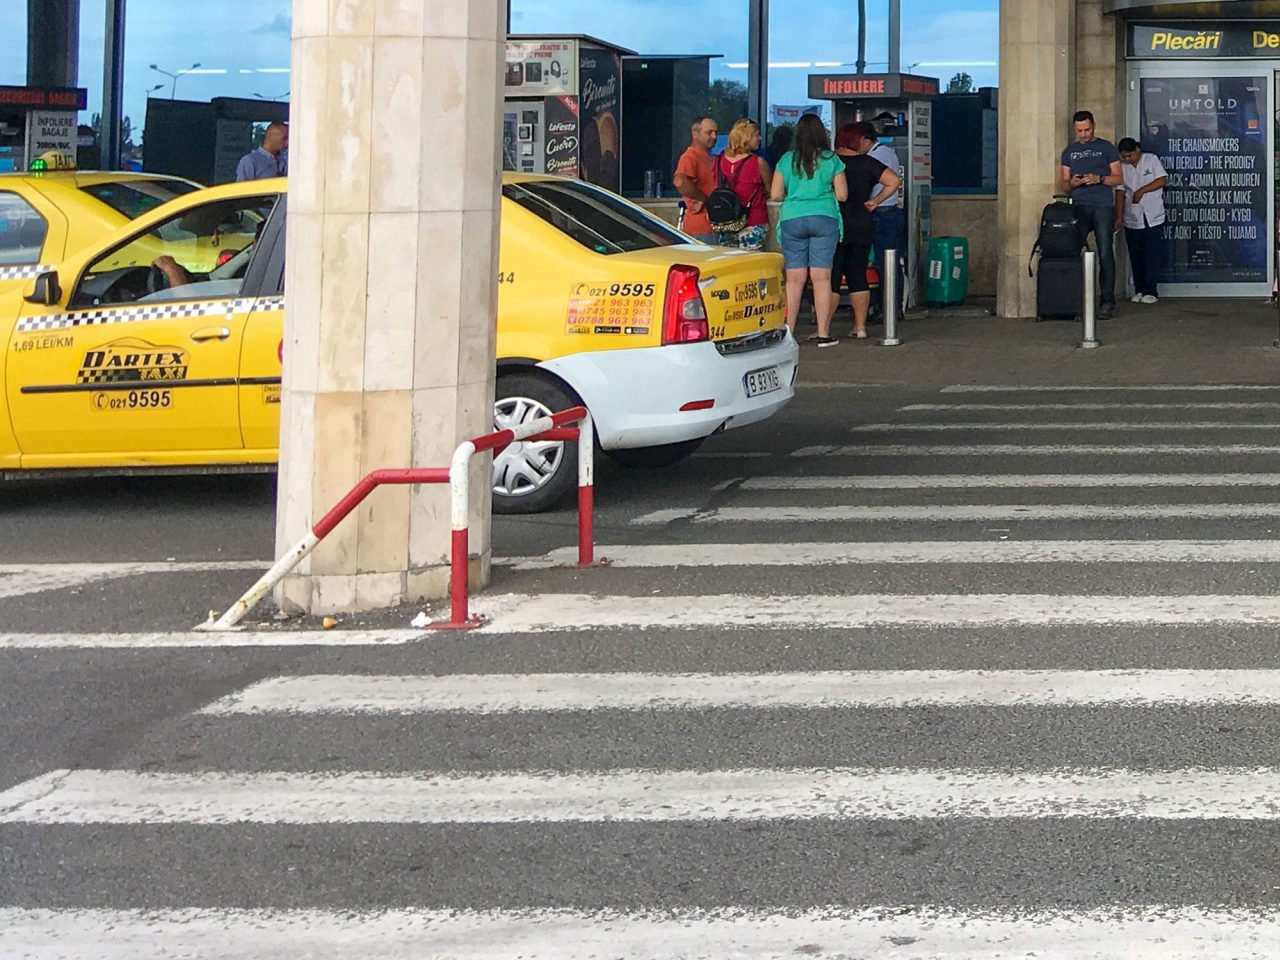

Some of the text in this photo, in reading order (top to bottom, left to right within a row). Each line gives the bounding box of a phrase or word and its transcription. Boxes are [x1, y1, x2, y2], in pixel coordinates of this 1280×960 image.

[1151, 31, 1220, 51] Plecări
[1169, 98, 1237, 110] UNTOLD
[1168, 138, 1239, 152] THE CHAINSMOKERS
[1209, 155, 1223, 169] THE
[1224, 155, 1256, 169] PRODIGY
[1189, 173, 1214, 187] ARMIN
[1215, 173, 1231, 187] VAN
[1231, 173, 1260, 187] BUUREN
[1184, 190, 1208, 205] VEGAS
[1208, 191, 1215, 204] &
[1216, 190, 1232, 204] LIKE
[1233, 190, 1252, 204] MIKE
[1183, 208, 1198, 222] DON
[1200, 208, 1226, 222] DIABLO
[1231, 208, 1251, 222] KYGO
[1174, 226, 1192, 240] AOKI
[1228, 226, 1257, 240] TUJAMO
[498, 271, 515, 284] 44
[589, 283, 656, 298] 021 9595
[610, 299, 629, 307] 963
[633, 299, 653, 308] 963
[632, 308, 652, 316] 963
[608, 317, 628, 325] 963
[631, 317, 651, 326] 963
[711, 326, 726, 339] 344
[14, 336, 74, 353] 1,69 LEI/KM
[750, 375, 757, 393] B
[757, 372, 767, 391] 93
[110, 391, 170, 409] 021 9595
